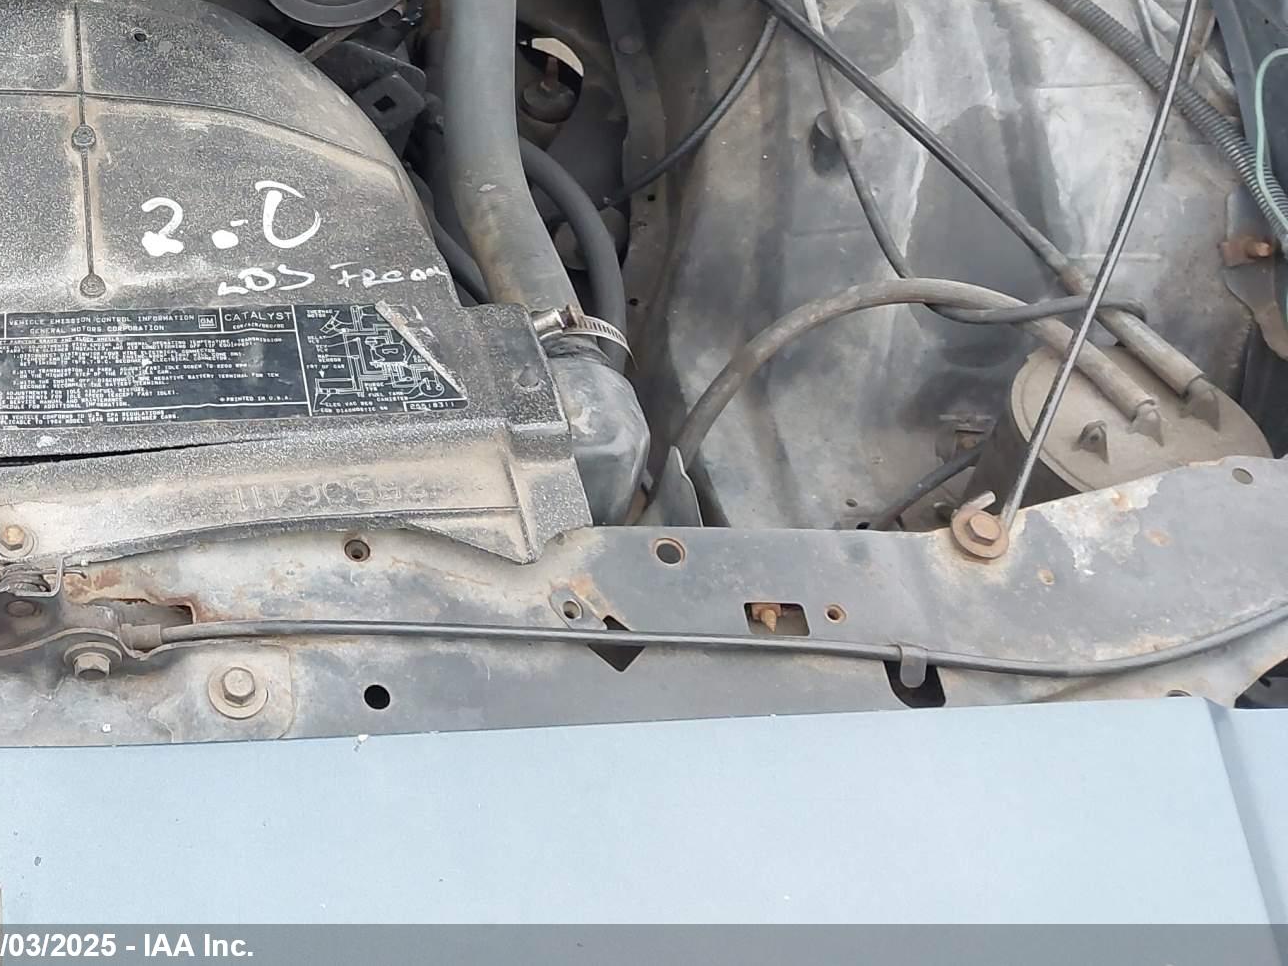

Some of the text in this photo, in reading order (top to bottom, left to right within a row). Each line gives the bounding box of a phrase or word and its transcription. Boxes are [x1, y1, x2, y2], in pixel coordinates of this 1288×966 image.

[50, 317, 90, 325] EMISSION
[96, 315, 132, 323] CONTROL
[137, 314, 195, 323] INFORMATION
[224, 311, 292, 322] CATALYST
[29, 328, 66, 336] GENERAL
[107, 325, 165, 333] CORPORATION
